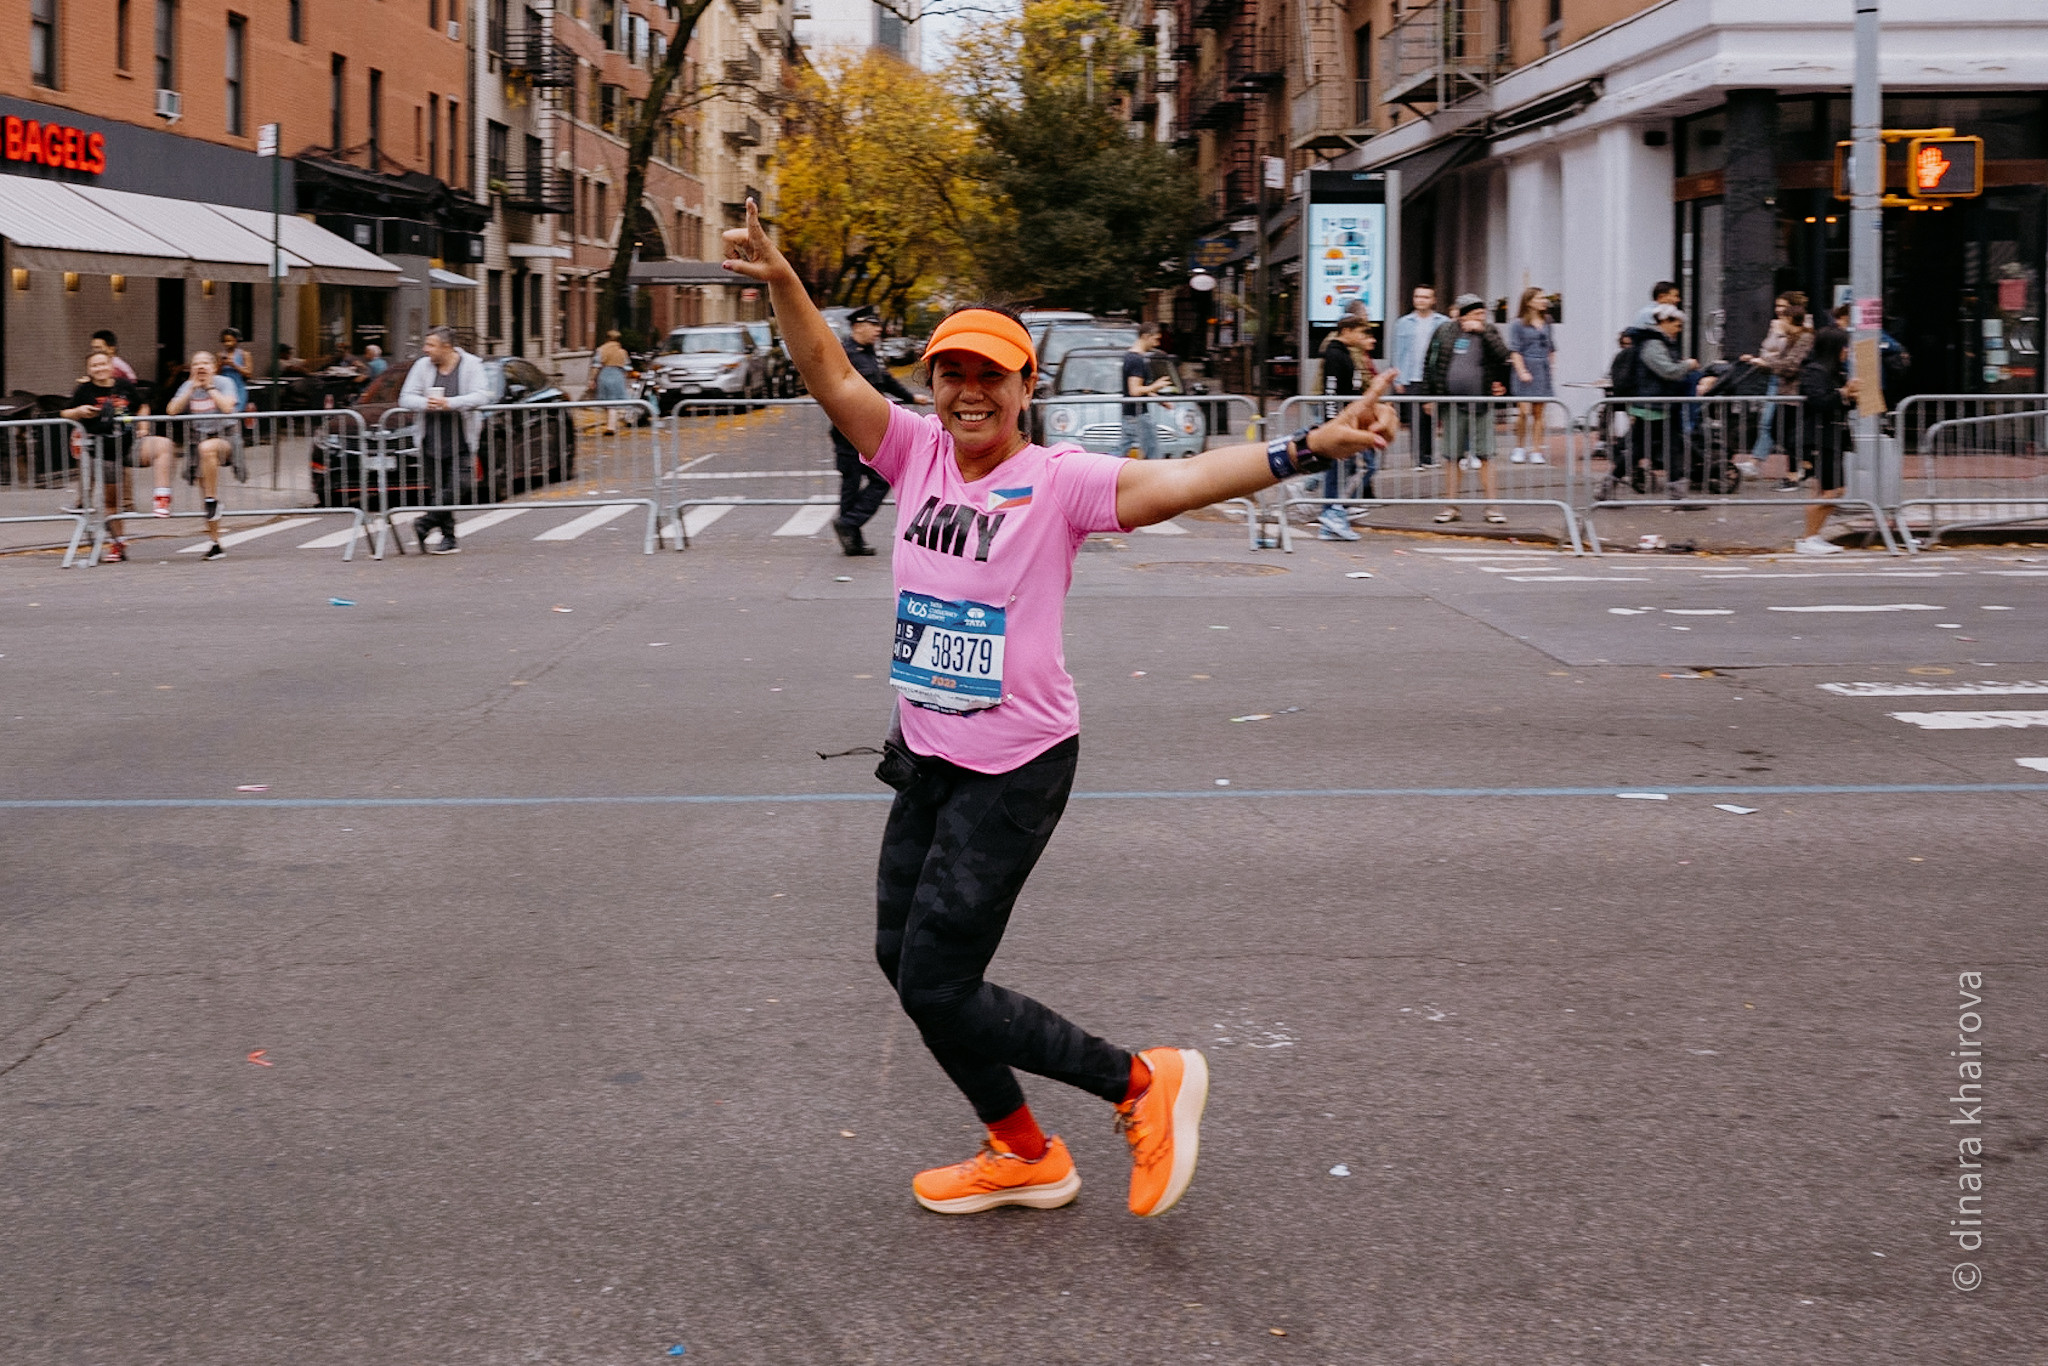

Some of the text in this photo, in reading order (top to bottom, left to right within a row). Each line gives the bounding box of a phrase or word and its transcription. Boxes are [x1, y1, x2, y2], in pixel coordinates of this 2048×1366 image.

[4, 115, 106, 175] BAGELS
[903, 495, 1006, 562] AMY
[964, 618, 987, 628] TATA
[931, 631, 992, 675] 58379
